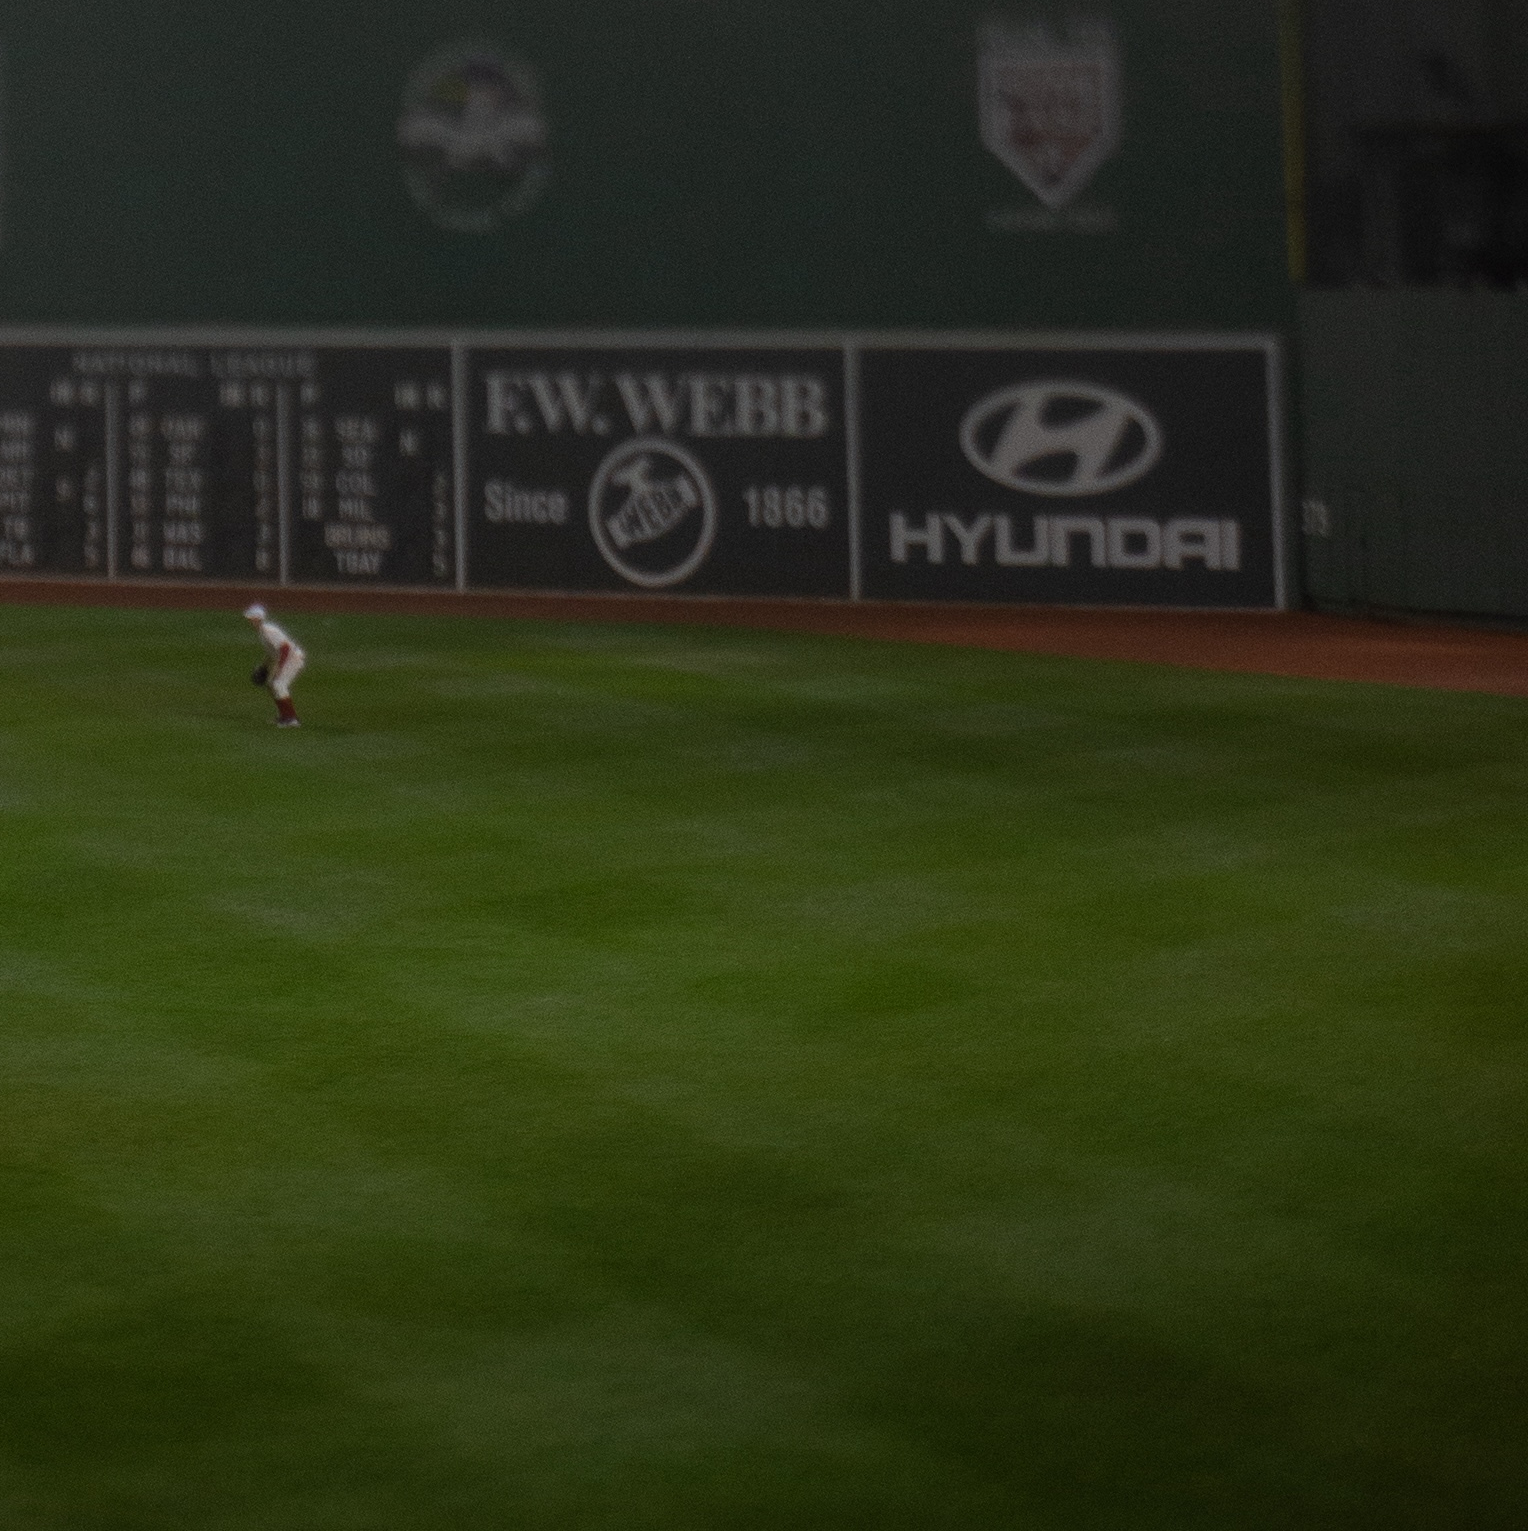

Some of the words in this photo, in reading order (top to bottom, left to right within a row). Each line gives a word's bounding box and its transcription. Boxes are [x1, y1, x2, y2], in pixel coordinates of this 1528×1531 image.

[615, 370, 828, 438] WEBB
[484, 479, 569, 524] Since
[888, 511, 1241, 572] HYUNDAI
